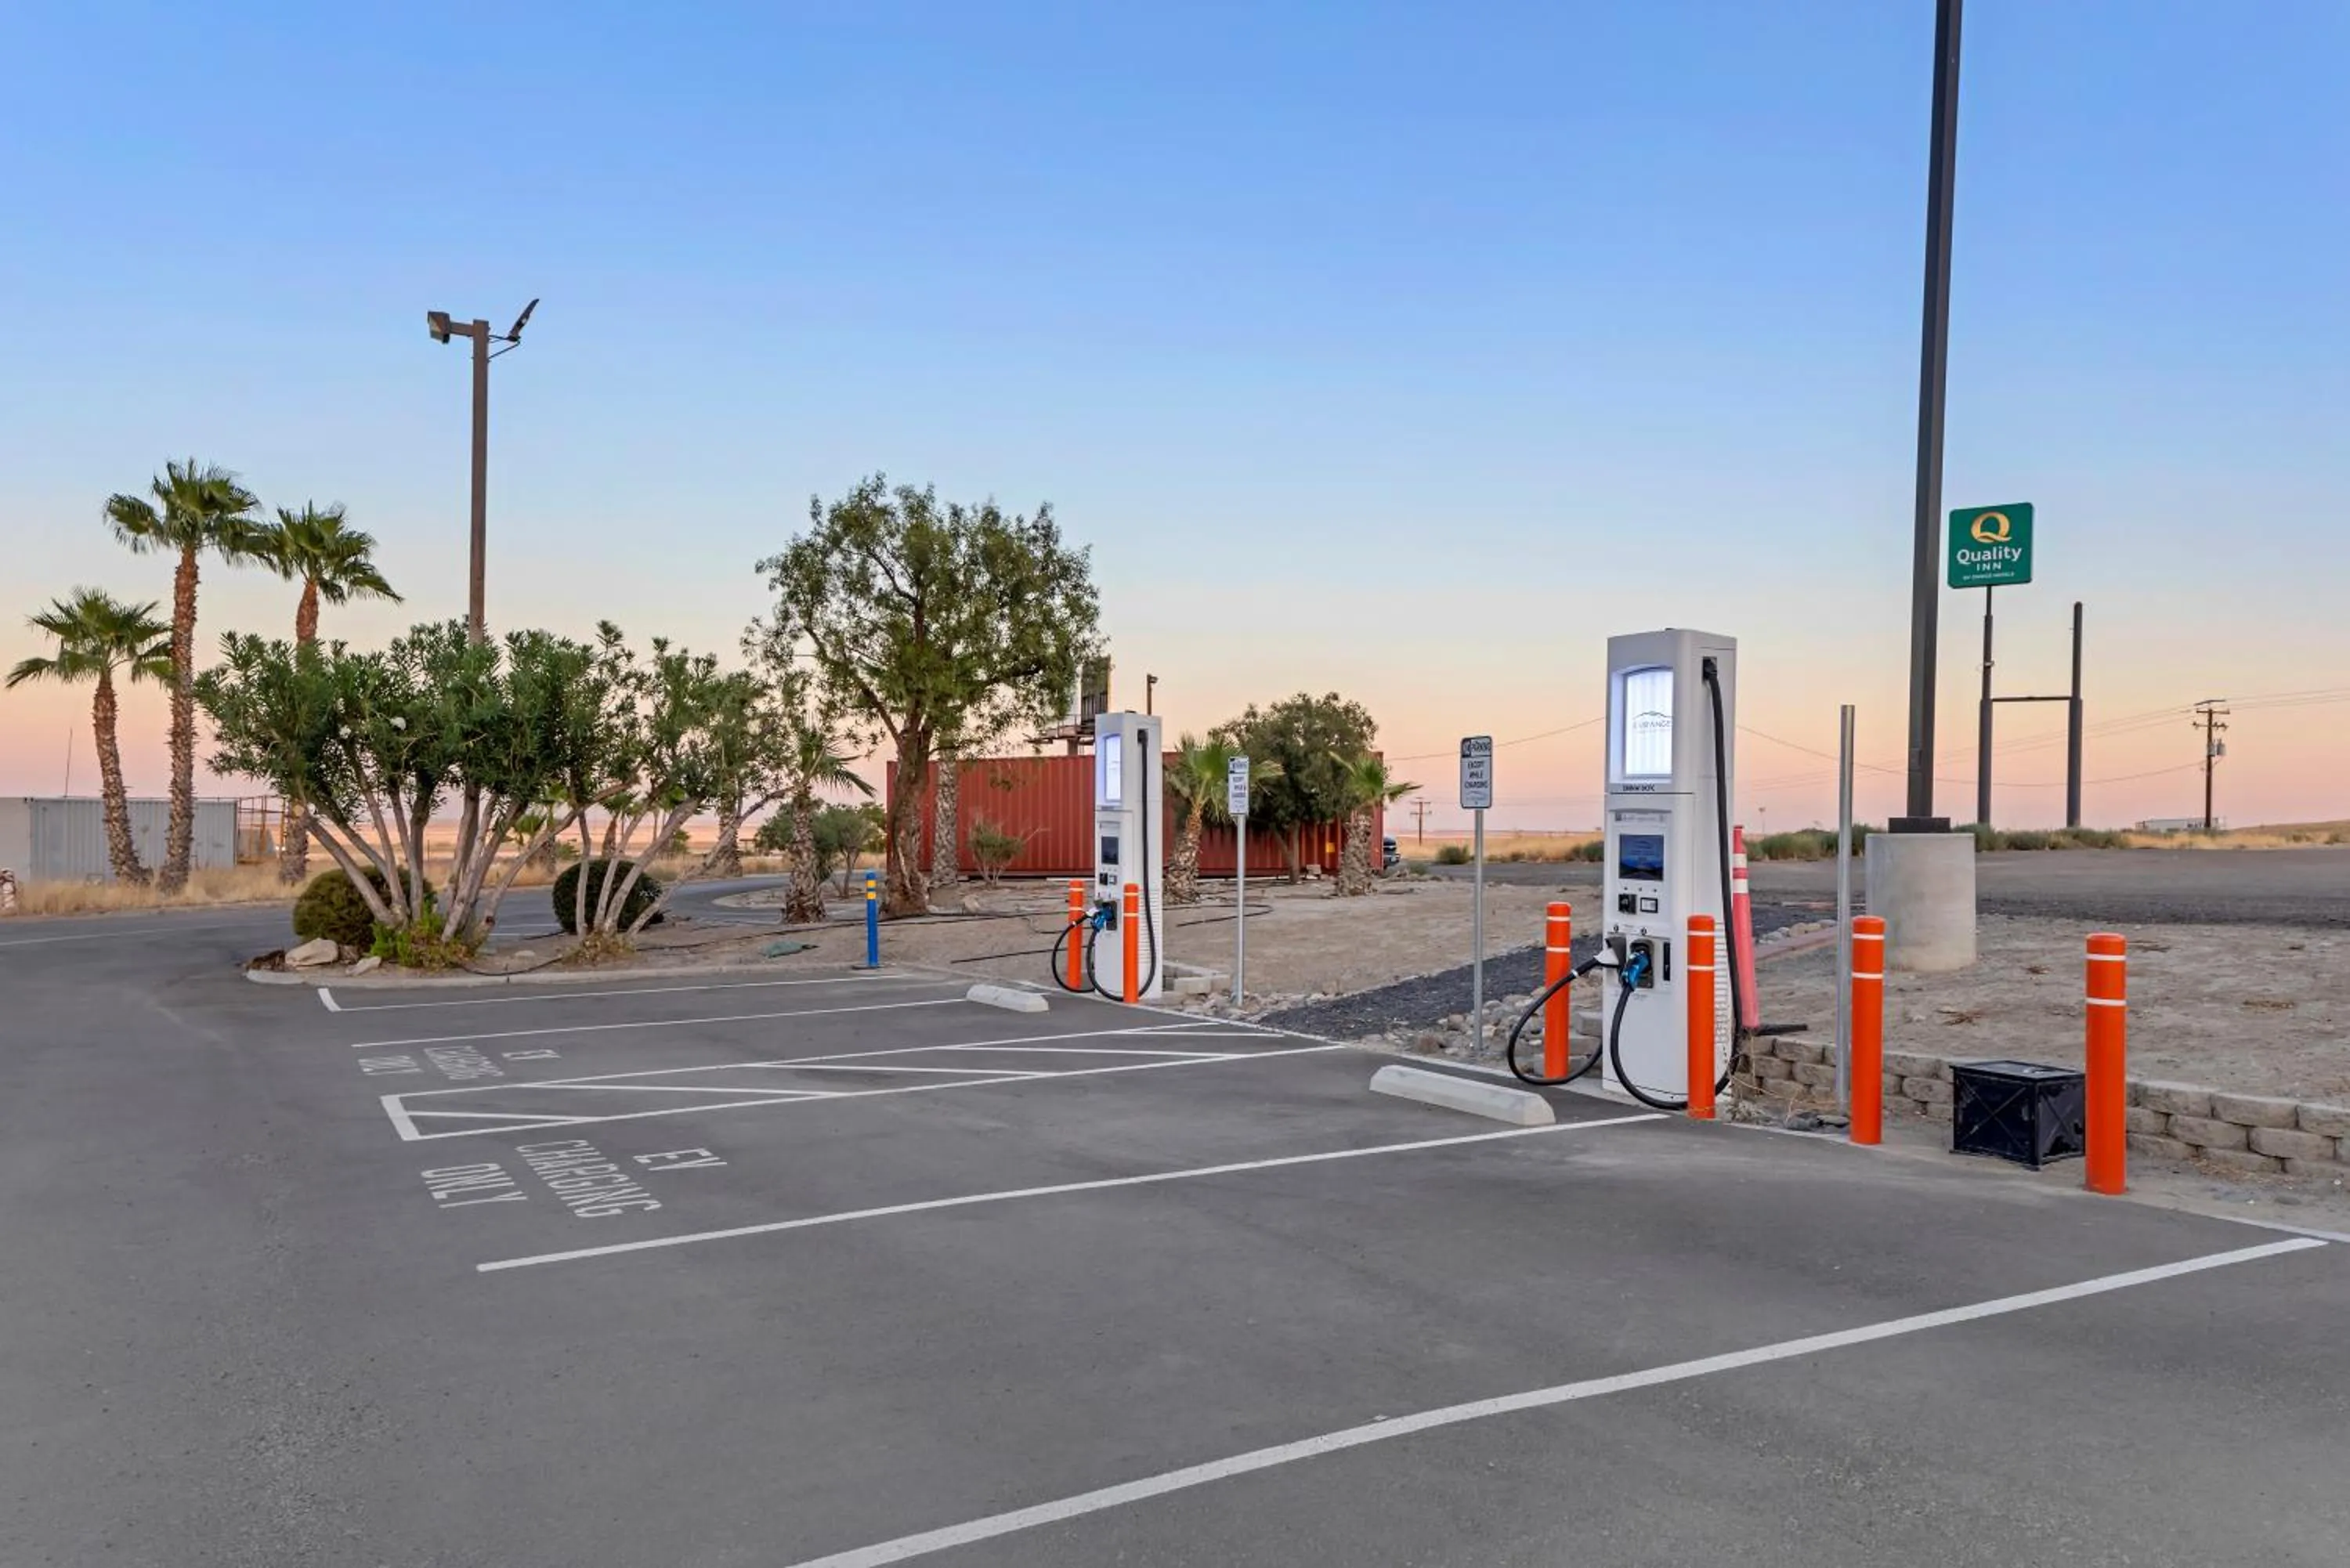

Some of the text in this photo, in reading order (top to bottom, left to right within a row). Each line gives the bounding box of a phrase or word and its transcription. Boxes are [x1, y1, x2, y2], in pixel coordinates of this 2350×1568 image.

[1971, 511, 2012, 543] Q
[1956, 546, 2022, 565] Quality
[1976, 562, 2001, 571] INN
[633, 1147, 728, 1172] EV
[421, 1163, 528, 1209] ONLY
[515, 1140, 662, 1219] CHARGING
